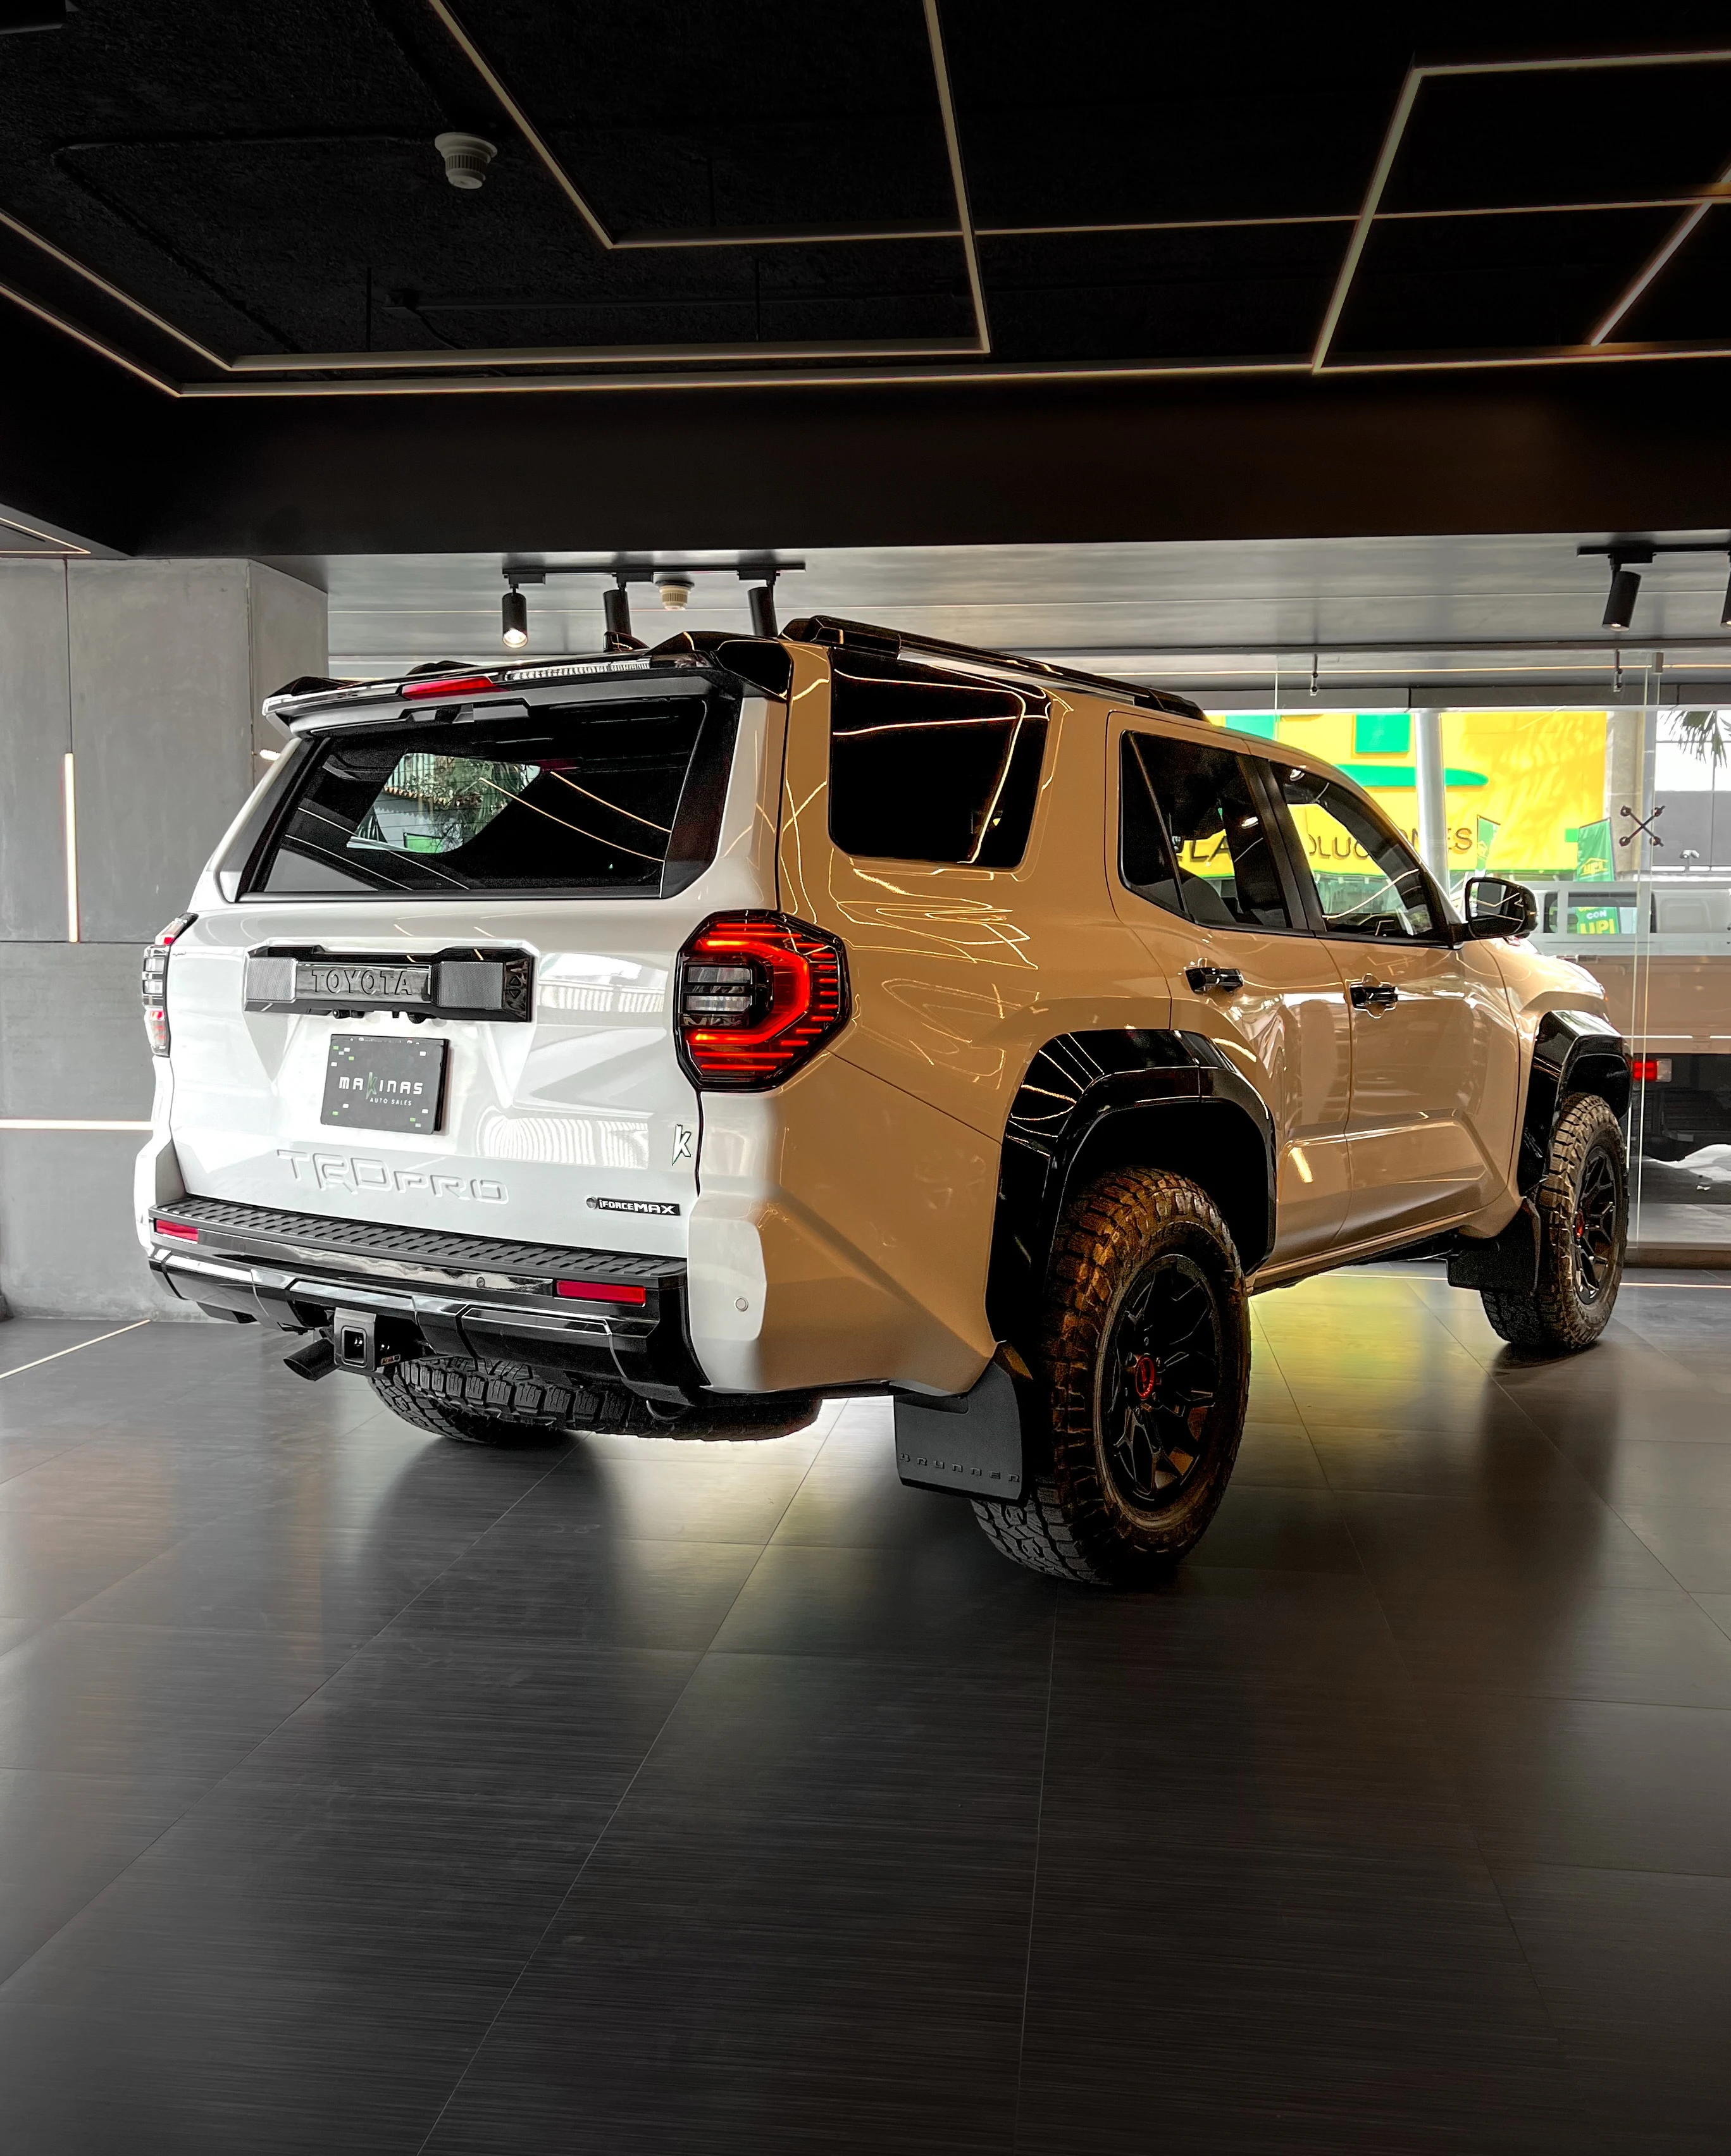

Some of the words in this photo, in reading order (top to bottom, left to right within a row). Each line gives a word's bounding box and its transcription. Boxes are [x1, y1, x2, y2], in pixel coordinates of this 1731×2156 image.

[1586, 910, 1607, 920] CON
[1580, 919, 1615, 934] UPI
[312, 969, 413, 996] TOYOTA
